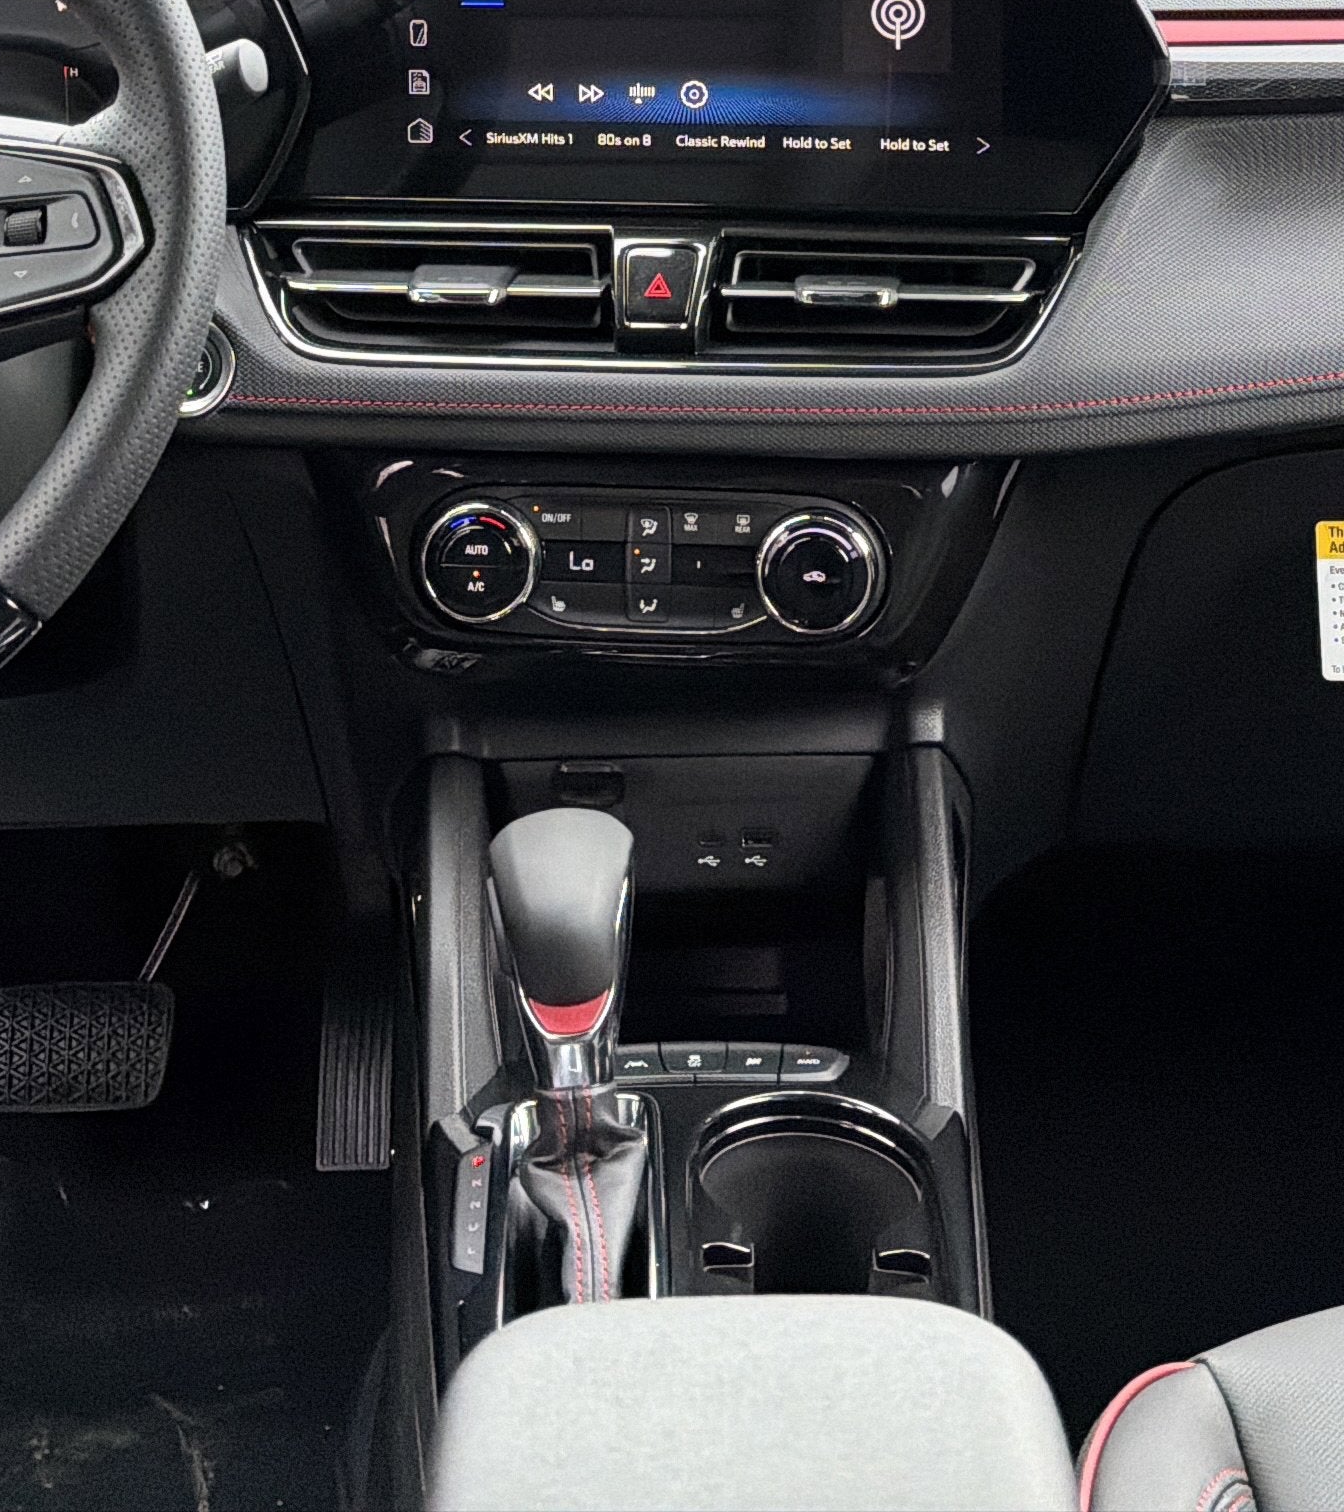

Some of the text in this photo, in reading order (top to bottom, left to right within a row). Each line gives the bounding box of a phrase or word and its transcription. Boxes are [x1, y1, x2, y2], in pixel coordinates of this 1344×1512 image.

[69, 67, 78, 77] H
[486, 132, 573, 145] SiriusXM Hits 1
[597, 133, 652, 146] 80s on 8
[676, 134, 766, 148] Classic Rewind
[783, 136, 852, 150] Hold to Set
[880, 138, 950, 152] Hold to Set
[542, 513, 572, 522] ON/OFF
[684, 524, 698, 532] MAX
[735, 525, 751, 533] REAR
[465, 545, 488, 555] AUTO
[569, 551, 594, 571] Lo
[467, 582, 485, 591] A/C
[1332, 666, 1340, 675] To
